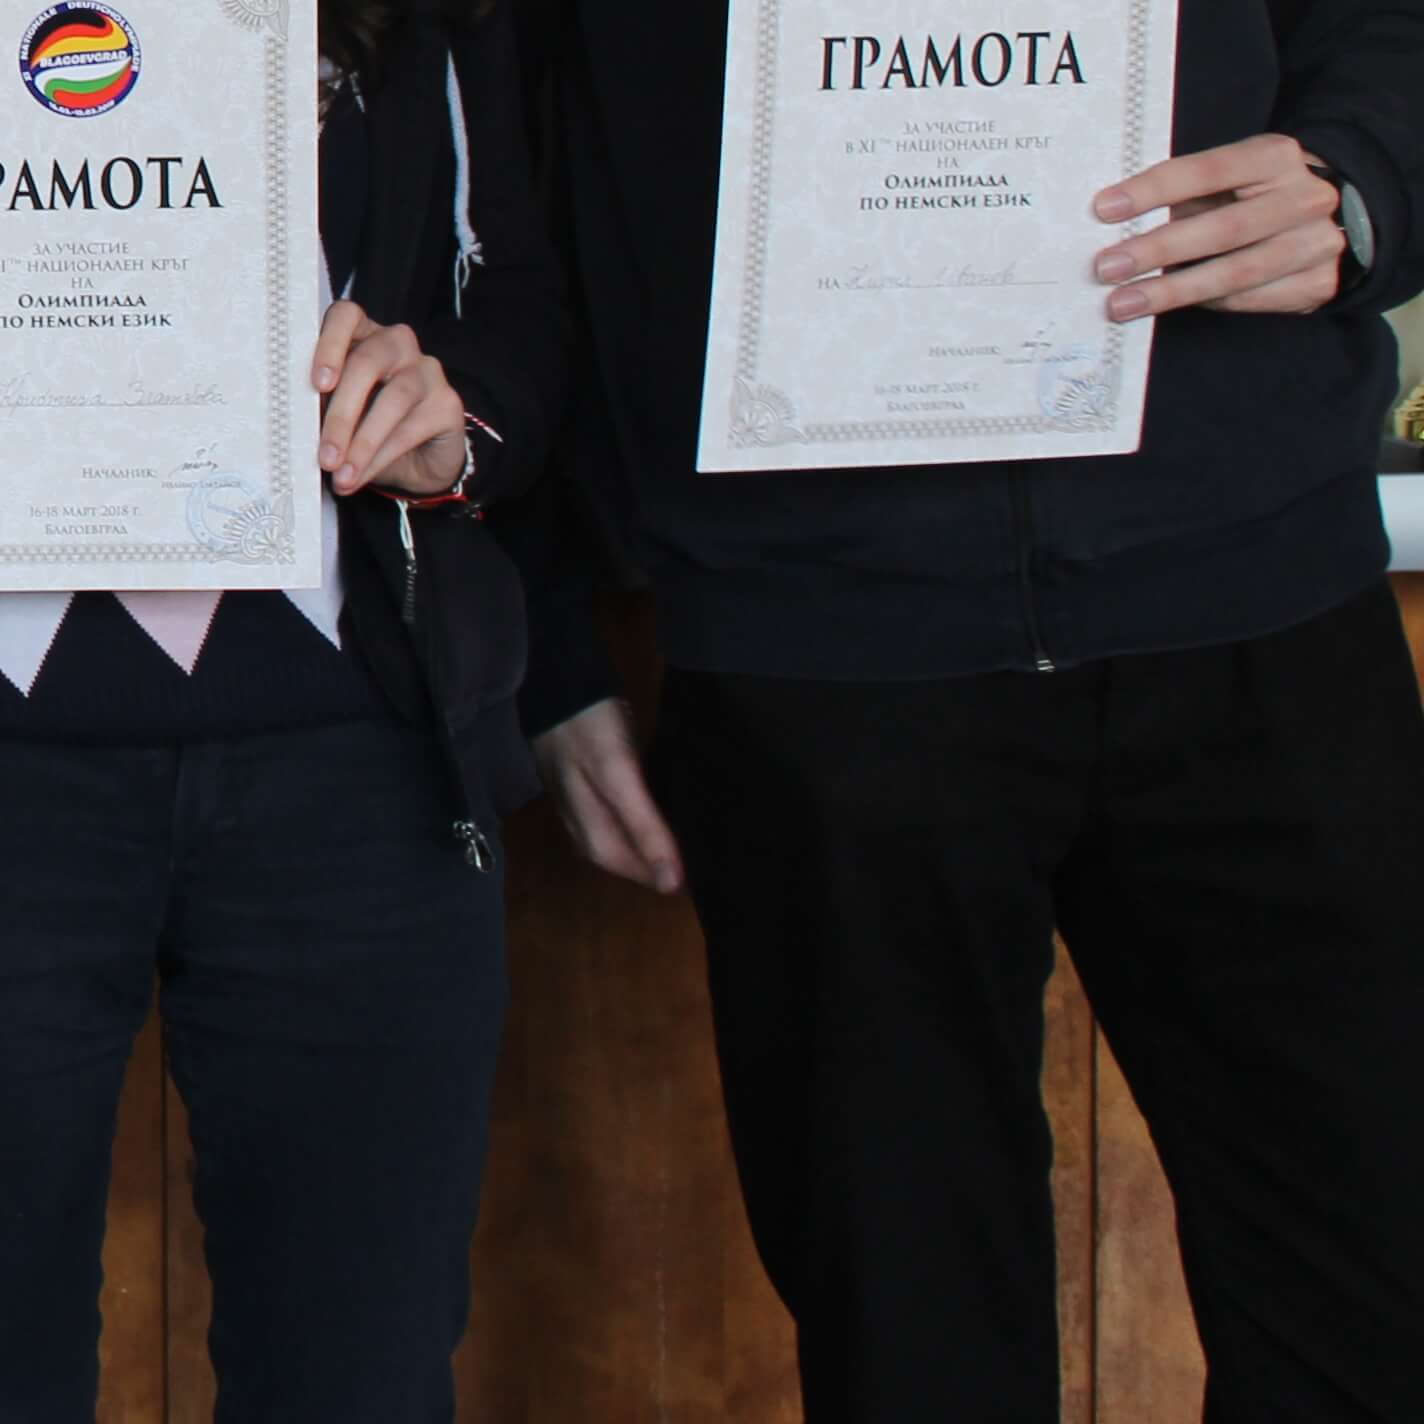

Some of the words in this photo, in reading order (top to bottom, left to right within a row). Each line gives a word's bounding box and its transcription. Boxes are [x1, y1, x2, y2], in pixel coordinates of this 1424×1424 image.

[20, 8, 58, 60] NATIONALE
[39, 51, 128, 68] BLAGOEVGRAD
[820, 30, 1087, 91] ГРАМОТА
[903, 122, 920, 136] ЗА
[925, 120, 997, 134] УЧАСТИЕ
[845, 141, 854, 154] В
[896, 137, 1009, 153] НАЦИОНАЛЕН
[1015, 136, 1053, 150] КРЪГ
[937, 156, 960, 169] НА
[860, 196, 888, 211] ПО
[895, 194, 977, 210] НЕМСКИ
[983, 192, 1033, 208] ЕЗИК
[33, 242, 51, 255] ЗА
[56, 242, 129, 256] УЧАСТИЕ
[27, 258, 144, 273] НАЦИОНАЛЕН
[151, 258, 191, 271] КРЪГ
[71, 277, 94, 289] НА
[818, 277, 840, 290] НА
[30, 314, 115, 329] НЕМСКИ
[122, 313, 172, 327] ЕЗИК
